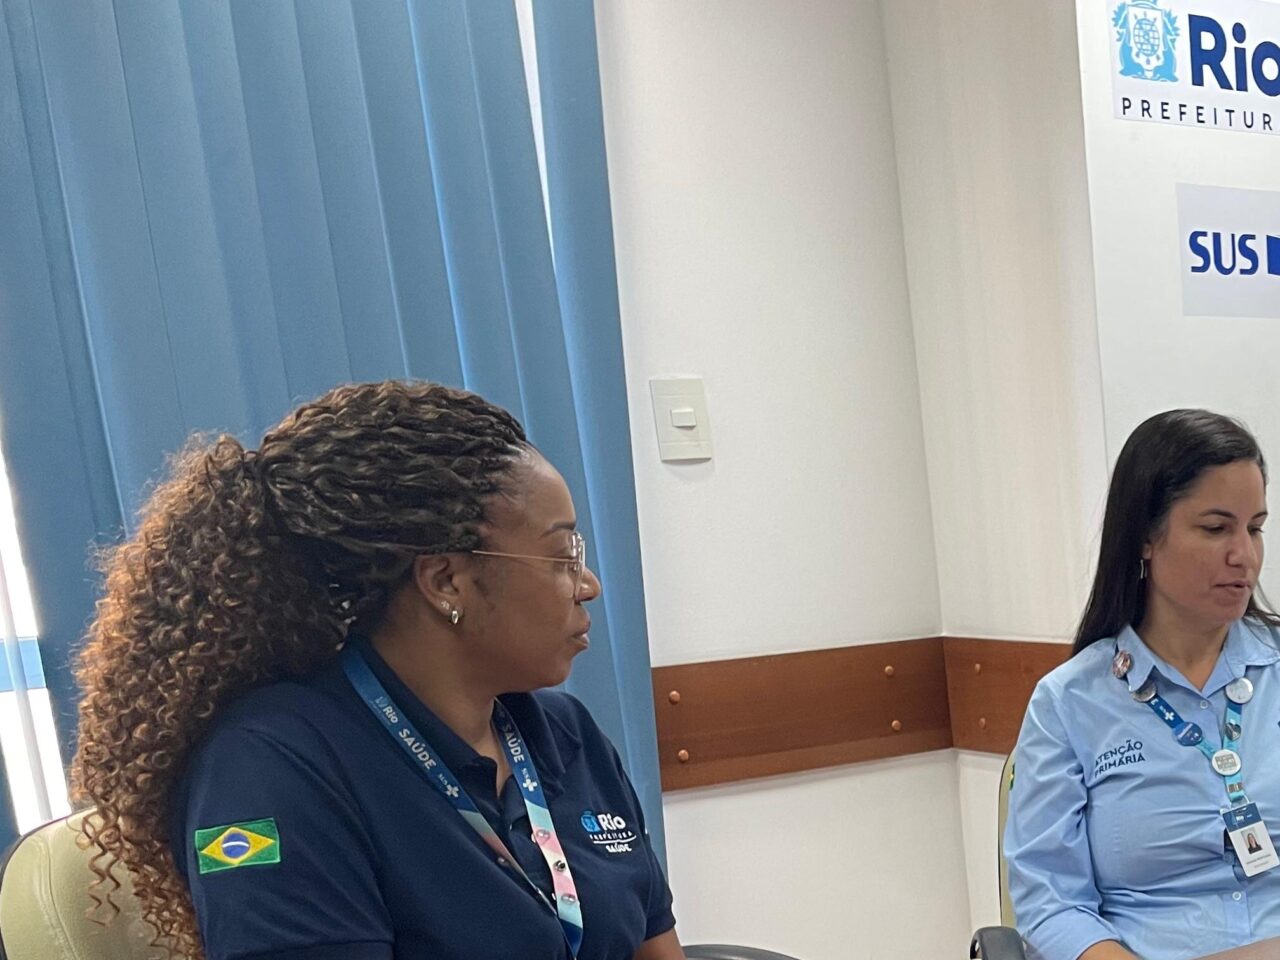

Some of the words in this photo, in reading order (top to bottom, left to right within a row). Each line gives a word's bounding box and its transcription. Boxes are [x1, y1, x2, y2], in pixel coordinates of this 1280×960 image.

[1188, 230, 1259, 275] SUS
[383, 705, 399, 724] Rio
[399, 728, 437, 770] SAÚDE
[503, 723, 525, 763] SAÚDE
[1095, 738, 1143, 768] ATENÇÃO
[1095, 752, 1146, 778] PRIMÁRIA
[597, 813, 626, 831] Rio
